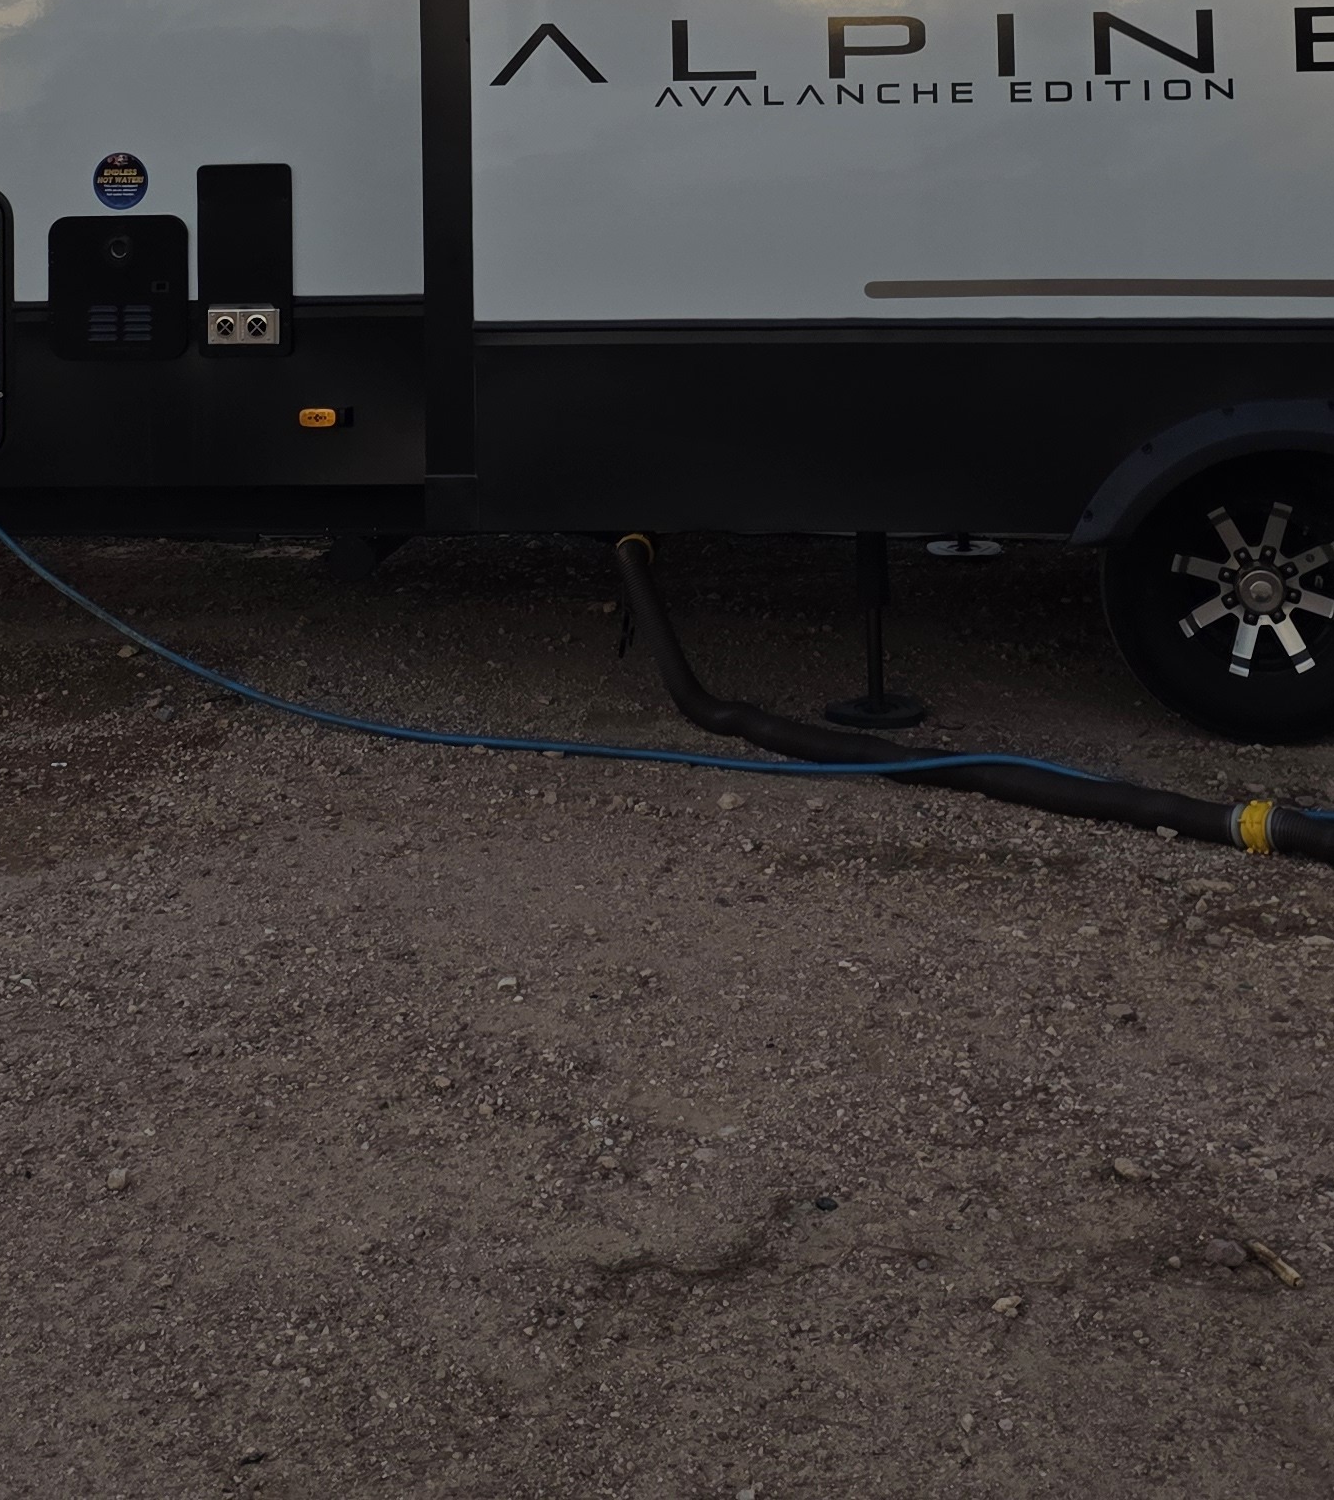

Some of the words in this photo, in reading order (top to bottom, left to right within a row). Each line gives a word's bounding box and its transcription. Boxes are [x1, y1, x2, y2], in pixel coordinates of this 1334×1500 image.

[654, 81, 974, 108] AVALANCHE
[1009, 77, 1235, 103] EDITION
[103, 168, 137, 176] ENDLESS
[97, 176, 113, 184] HOT
